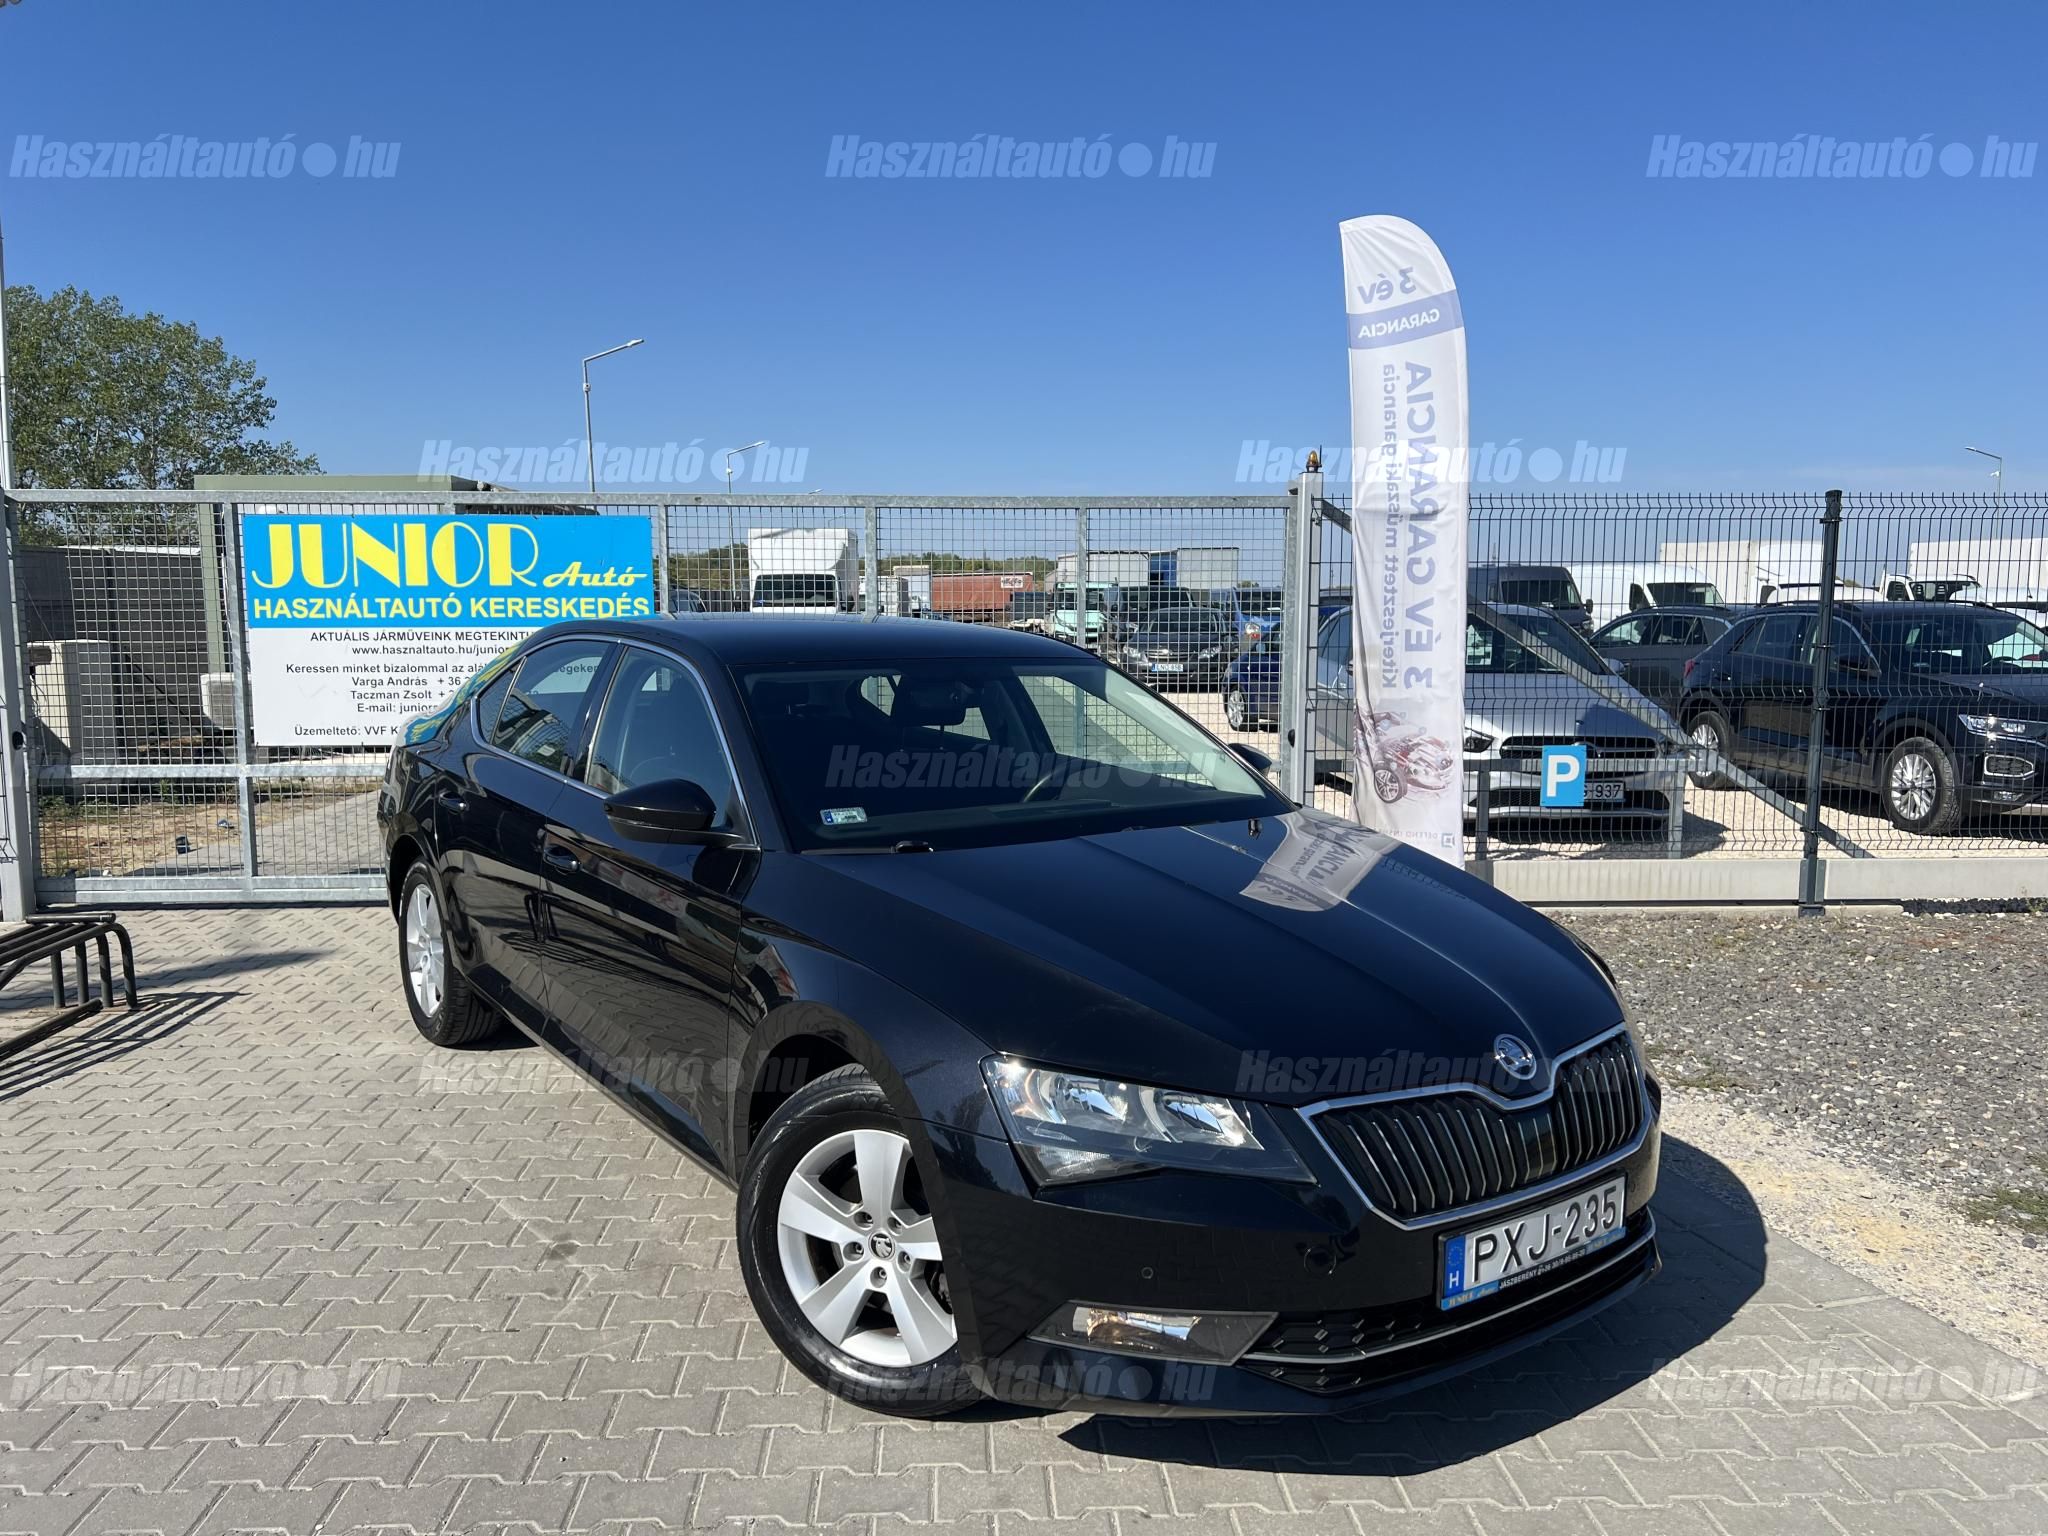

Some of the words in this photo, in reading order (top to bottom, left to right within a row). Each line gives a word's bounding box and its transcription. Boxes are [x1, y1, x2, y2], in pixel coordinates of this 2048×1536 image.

[252, 521, 538, 588] JUNIOR
[543, 561, 648, 588] Autó
[254, 593, 463, 619] HASZNÁLTAUTÓ
[470, 592, 650, 619] KERESKEDÉS
[310, 629, 370, 641] AKTUÁLIS
[373, 629, 451, 641] JÁRMŰVEINK
[286, 664, 339, 673] Keressen
[343, 664, 380, 673] minket
[384, 664, 447, 673] bizalommal
[352, 677, 384, 688] Varga
[387, 676, 428, 686] András
[448, 677, 461, 686] 36
[350, 690, 399, 699] Taczman
[403, 690, 432, 699] Zsolt
[357, 703, 396, 712] E-mail:
[294, 724, 360, 736] Üzemeltető:
[364, 726, 387, 735] VVF
[1547, 755, 1580, 797] P
[1472, 1185, 1617, 1283] PXJ-235
[1449, 1270, 1460, 1289] H
